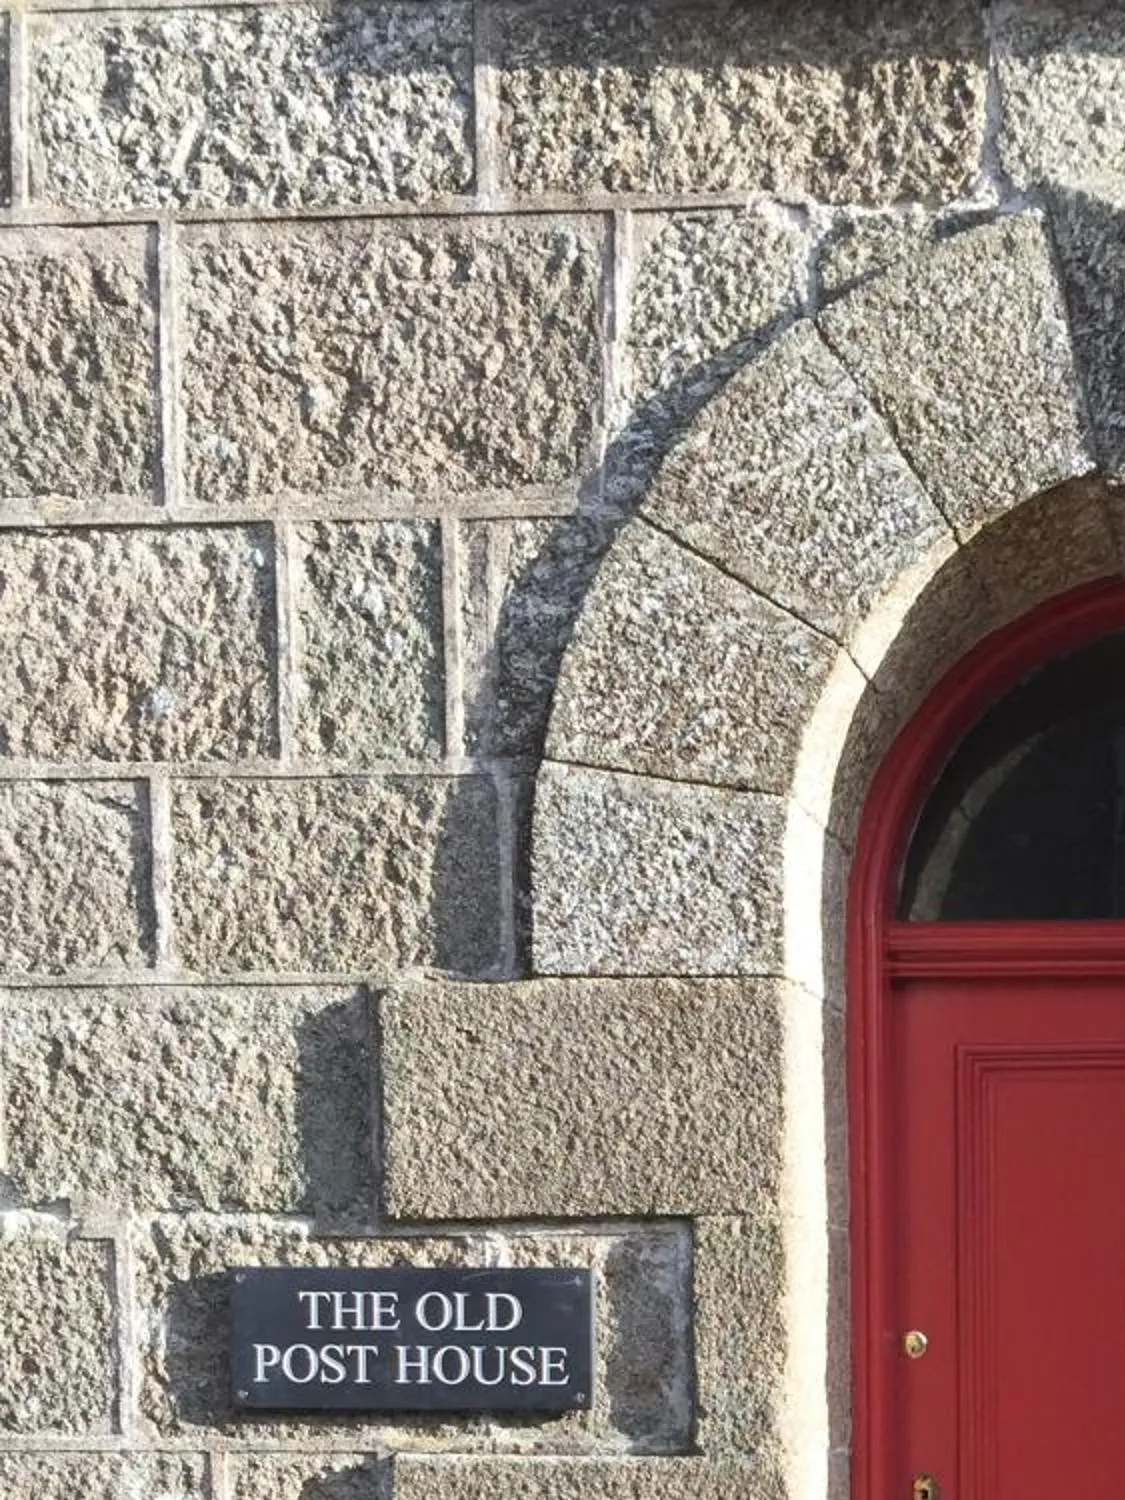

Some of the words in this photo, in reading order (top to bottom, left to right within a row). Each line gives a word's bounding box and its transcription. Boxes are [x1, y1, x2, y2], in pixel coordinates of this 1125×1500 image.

[299, 1291, 401, 1331] THE
[415, 1291, 523, 1332] OLD
[252, 1343, 379, 1384] POST
[394, 1345, 570, 1386] HOUSE
